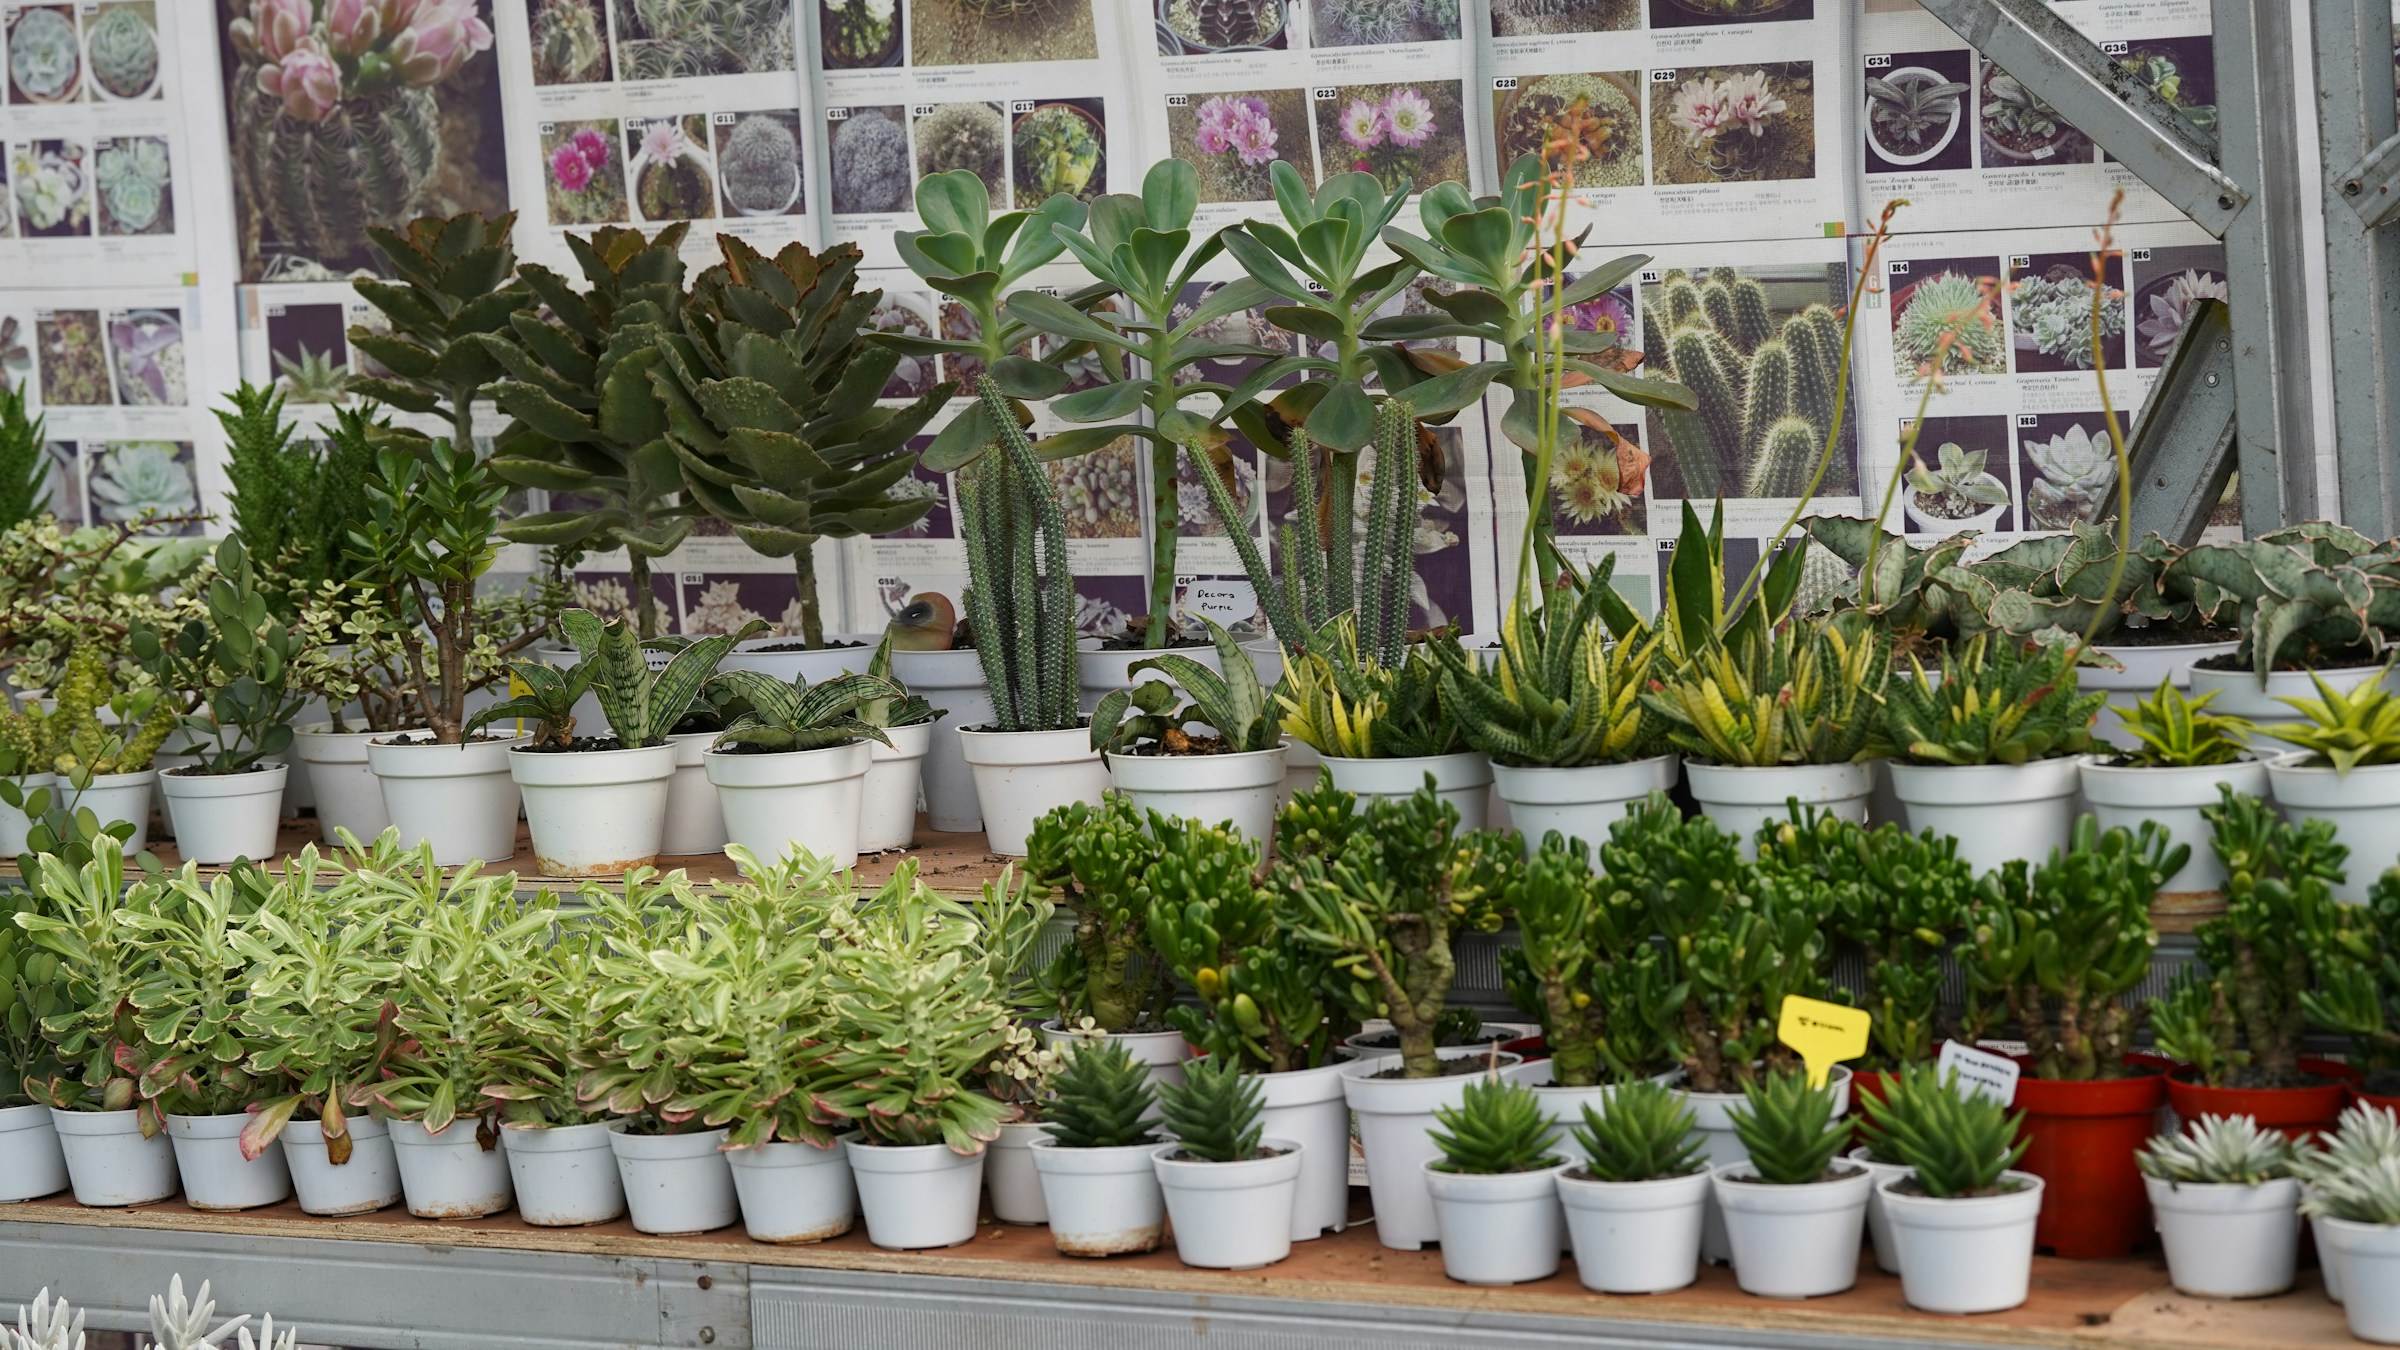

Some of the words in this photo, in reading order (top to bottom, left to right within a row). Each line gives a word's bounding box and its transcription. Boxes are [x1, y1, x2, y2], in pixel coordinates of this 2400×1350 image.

[2104, 44, 2127, 53] G36
[1868, 57, 1891, 66] G34
[1654, 72, 1675, 80] G29
[1496, 79, 1517, 88] G28
[1317, 89, 1336, 98] G23
[1169, 97, 1187, 105] G22
[915, 106, 933, 114] G16
[1015, 103, 1033, 111] G17
[829, 110, 847, 118] G15
[716, 115, 734, 123] G11
[2133, 251, 2149, 260] H6
[2013, 257, 2028, 266] H5
[1892, 264, 1908, 273] H4
[1643, 272, 1657, 280] H1
[2020, 417, 2036, 426] H8
[1660, 541, 1675, 549] H2
